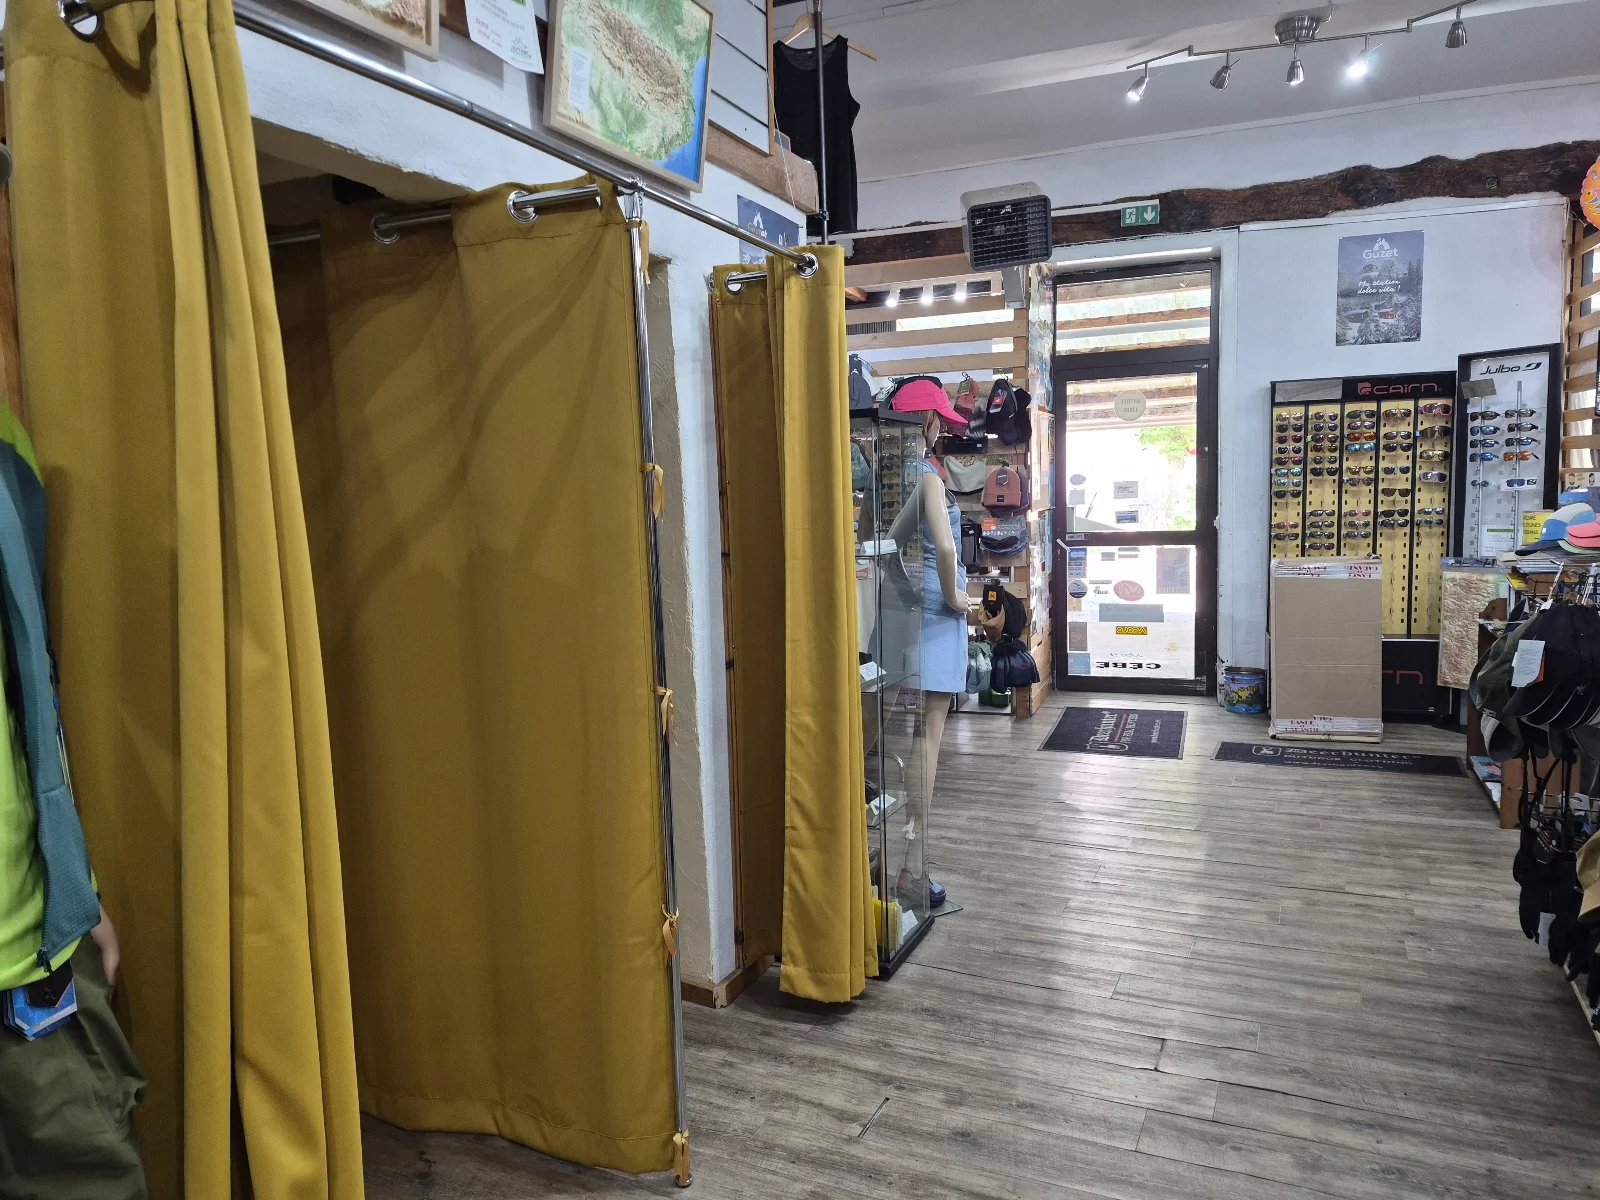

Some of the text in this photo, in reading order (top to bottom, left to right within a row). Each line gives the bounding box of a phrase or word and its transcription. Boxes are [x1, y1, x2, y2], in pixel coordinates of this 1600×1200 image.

[1362, 247, 1399, 260] Guzet
[1357, 286, 1378, 295] dolce
[1479, 362, 1521, 376] Julbo
